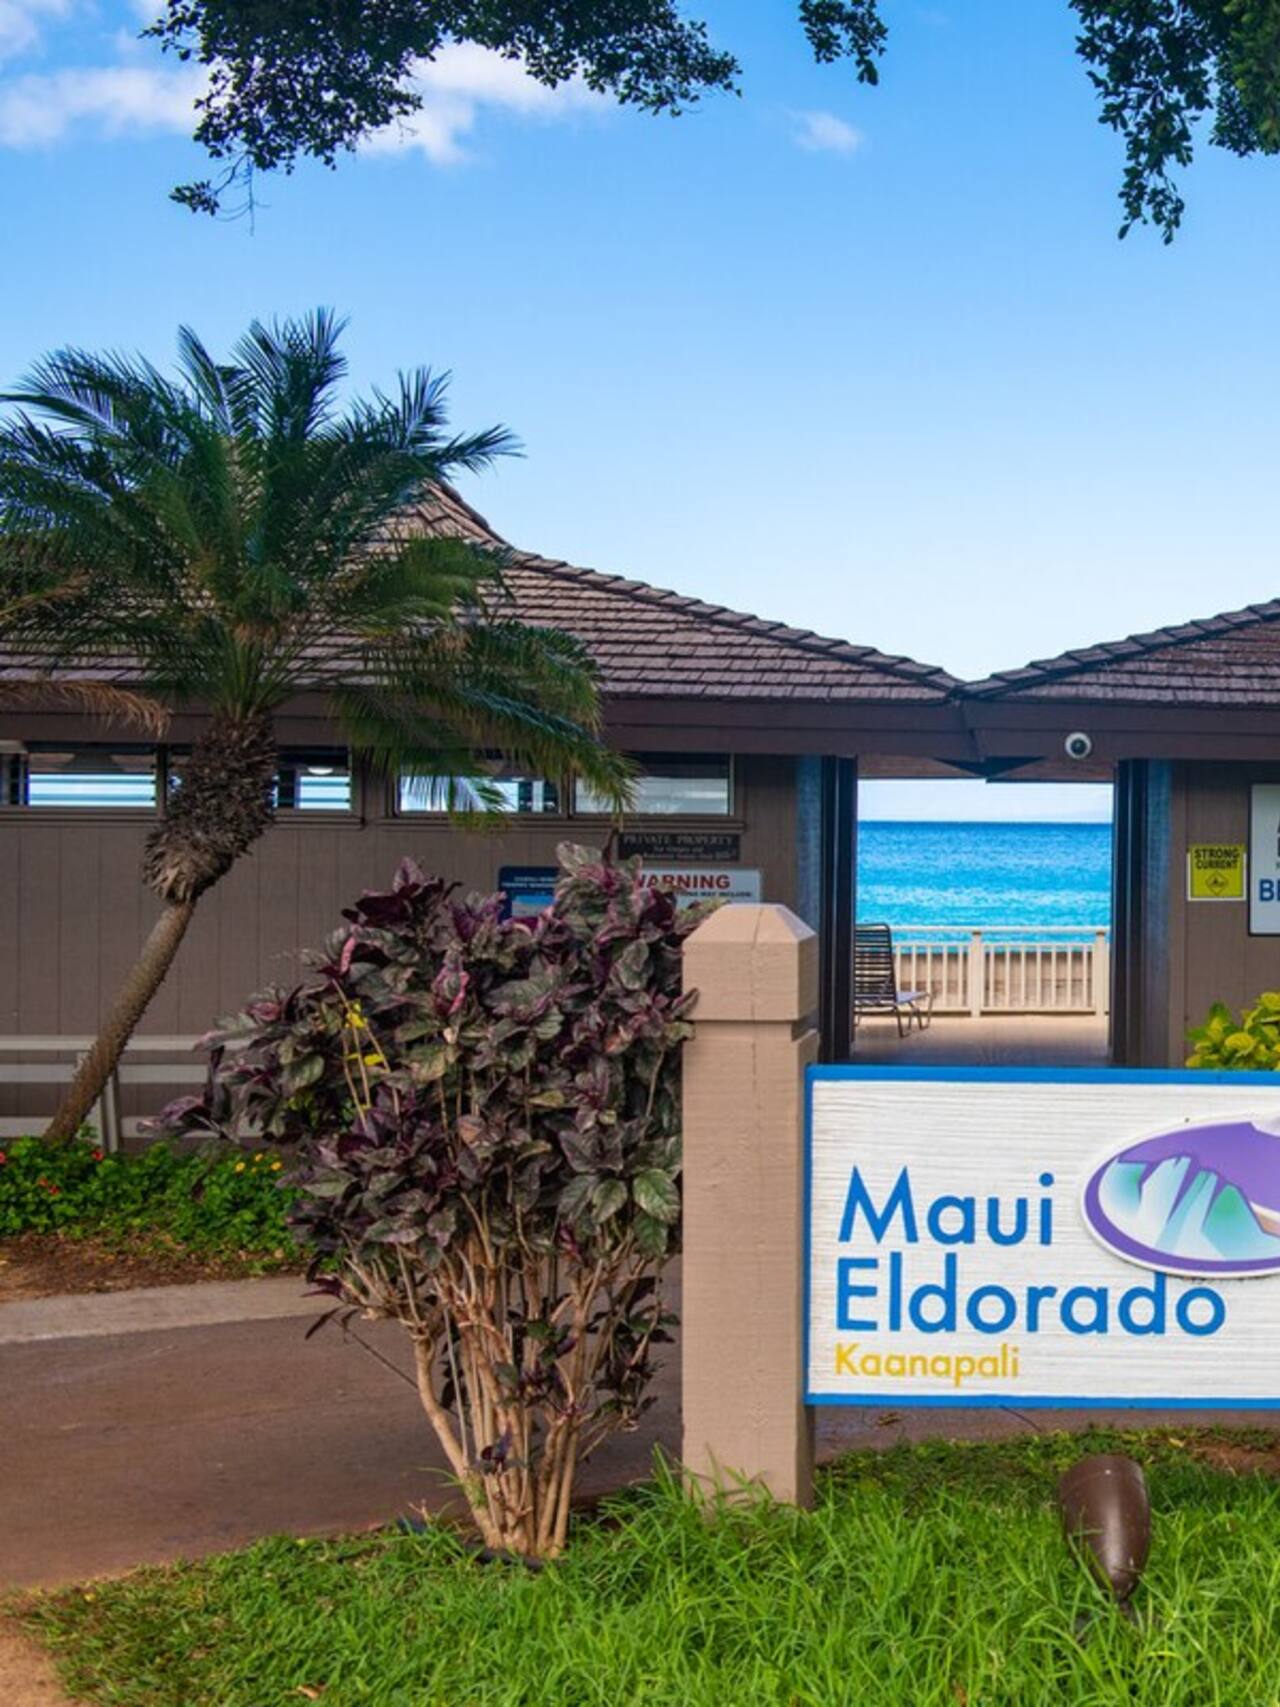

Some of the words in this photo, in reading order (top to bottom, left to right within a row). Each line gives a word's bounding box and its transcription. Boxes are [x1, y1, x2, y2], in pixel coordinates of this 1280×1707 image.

[1194, 848, 1240, 859] STRONG
[1195, 860, 1238, 870] CURRENT
[638, 874, 730, 889] ARNING
[838, 1164, 1054, 1247] Maui
[836, 1252, 1227, 1337] Eldorado
[834, 1342, 1020, 1387] Kaanapali
